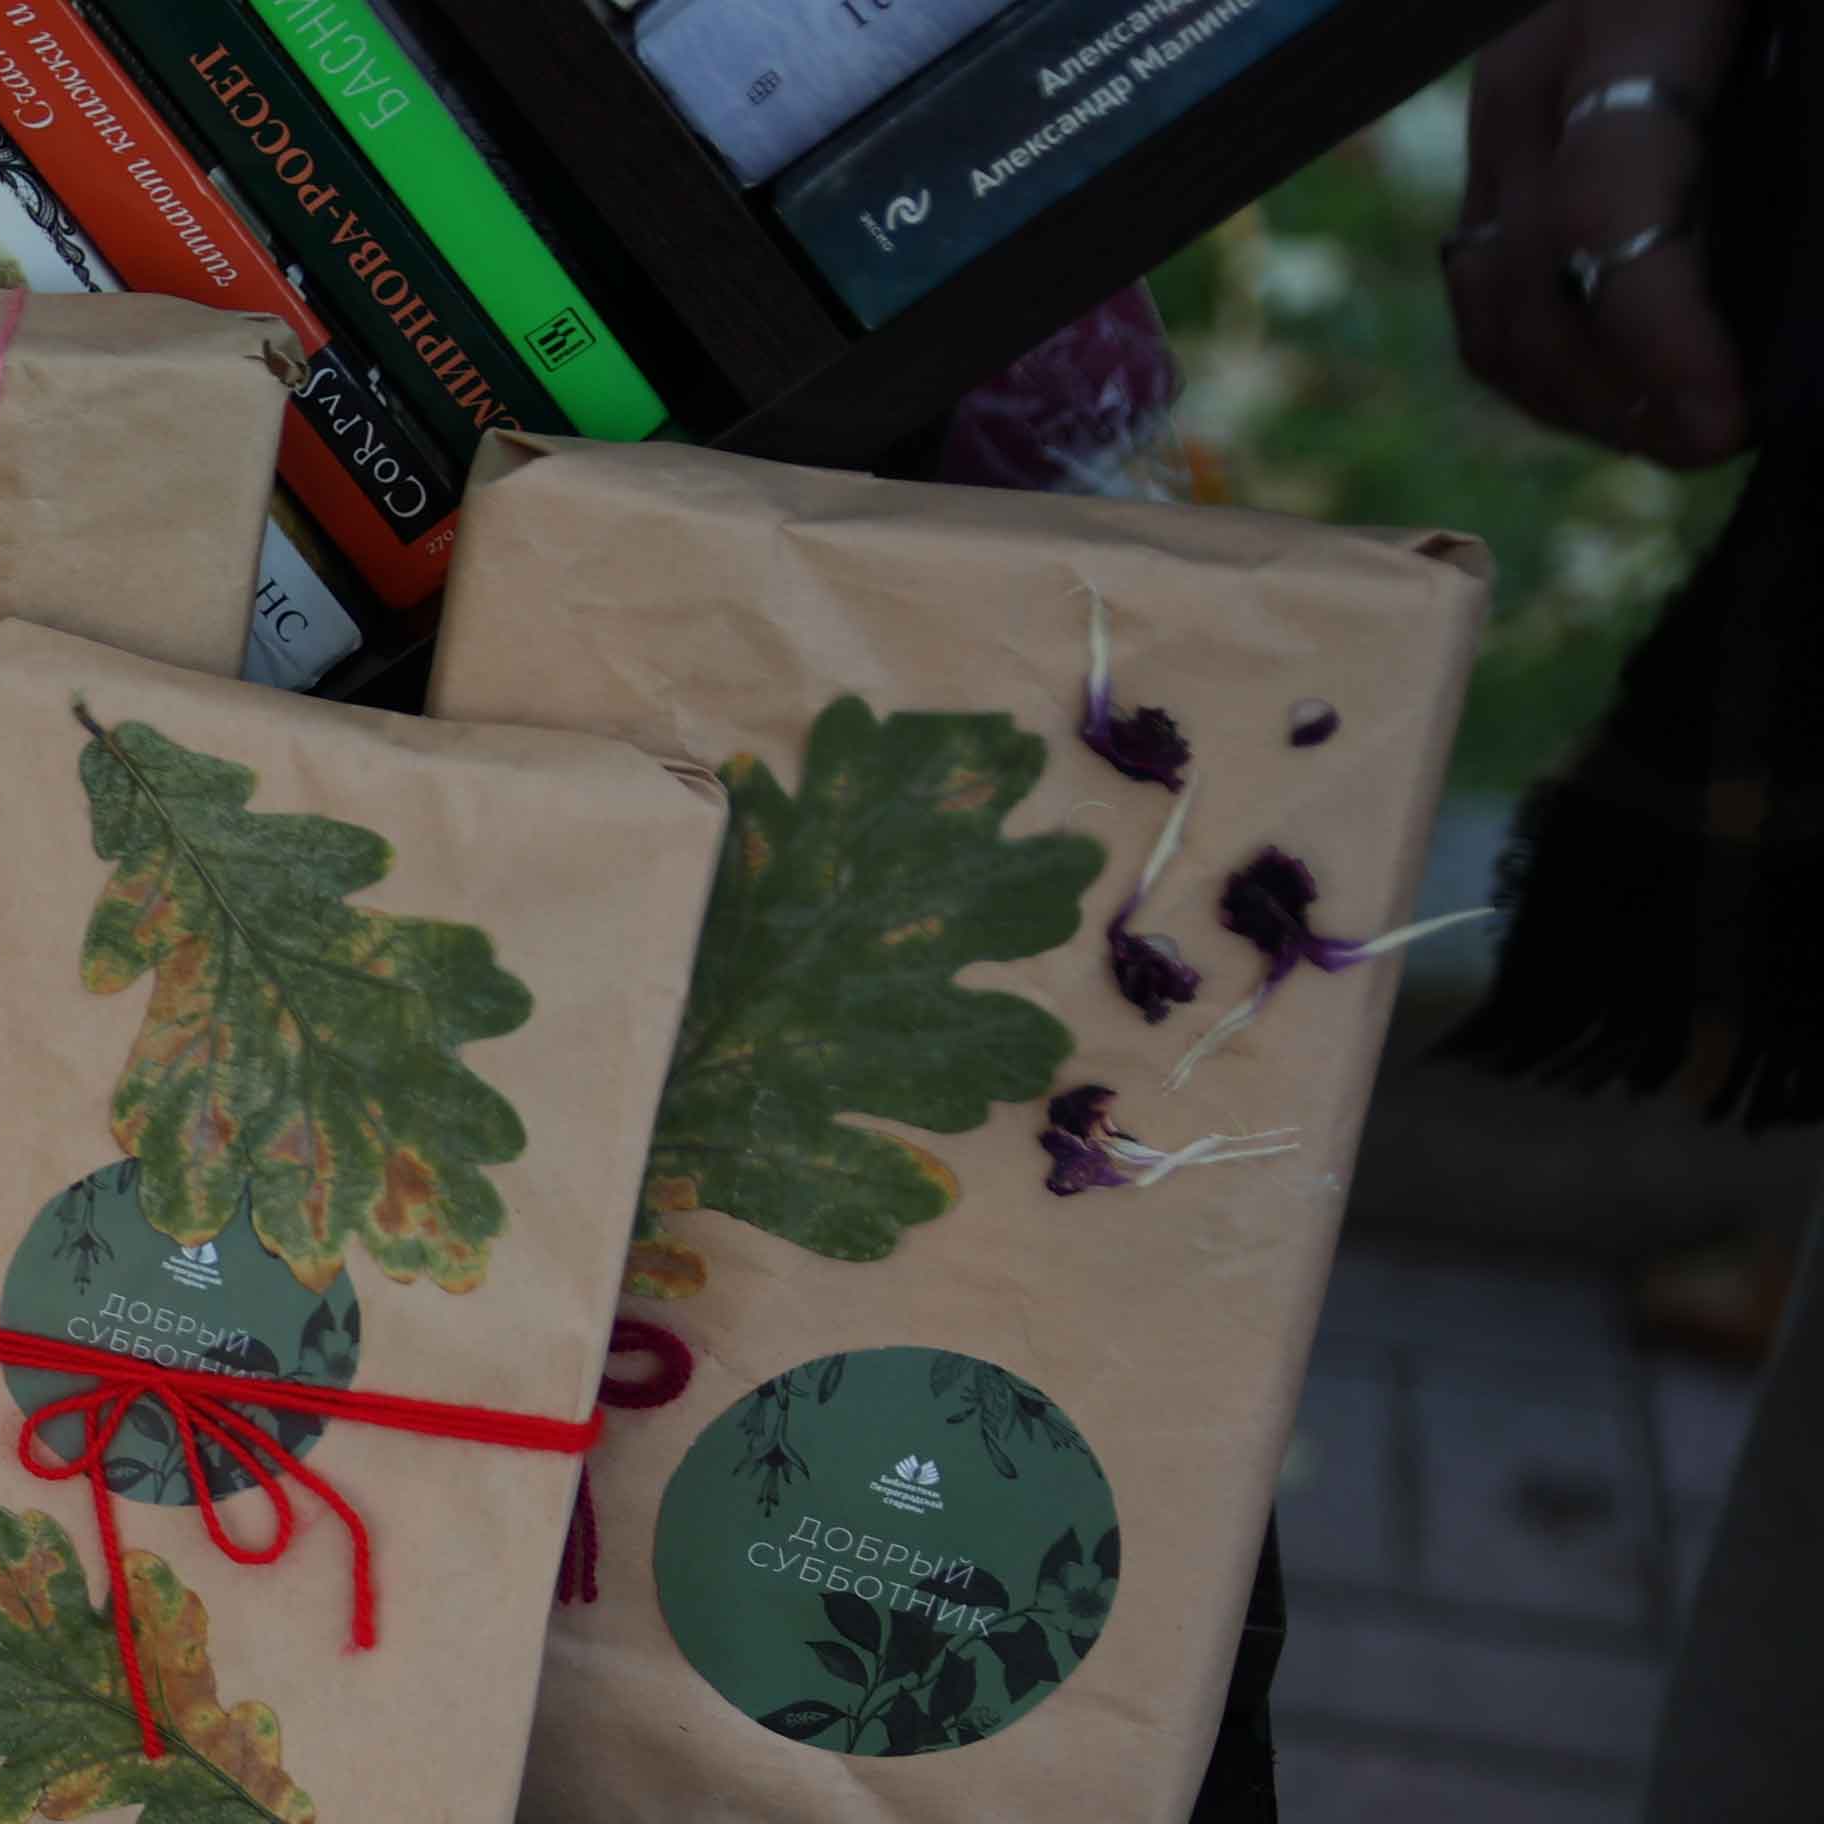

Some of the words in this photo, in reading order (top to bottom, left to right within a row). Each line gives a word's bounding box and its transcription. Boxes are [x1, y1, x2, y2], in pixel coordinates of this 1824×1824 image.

[6, 3, 36, 27] и
[28, 31, 136, 155] книжки
[969, 73, 1134, 199] Александр
[127, 157, 237, 287] читают
[99, 1292, 250, 1358] ДОБРЫЙ
[747, 1541, 997, 1637] СУББОТНИК
[787, 1515, 976, 1589] ДОБРЫЙ
